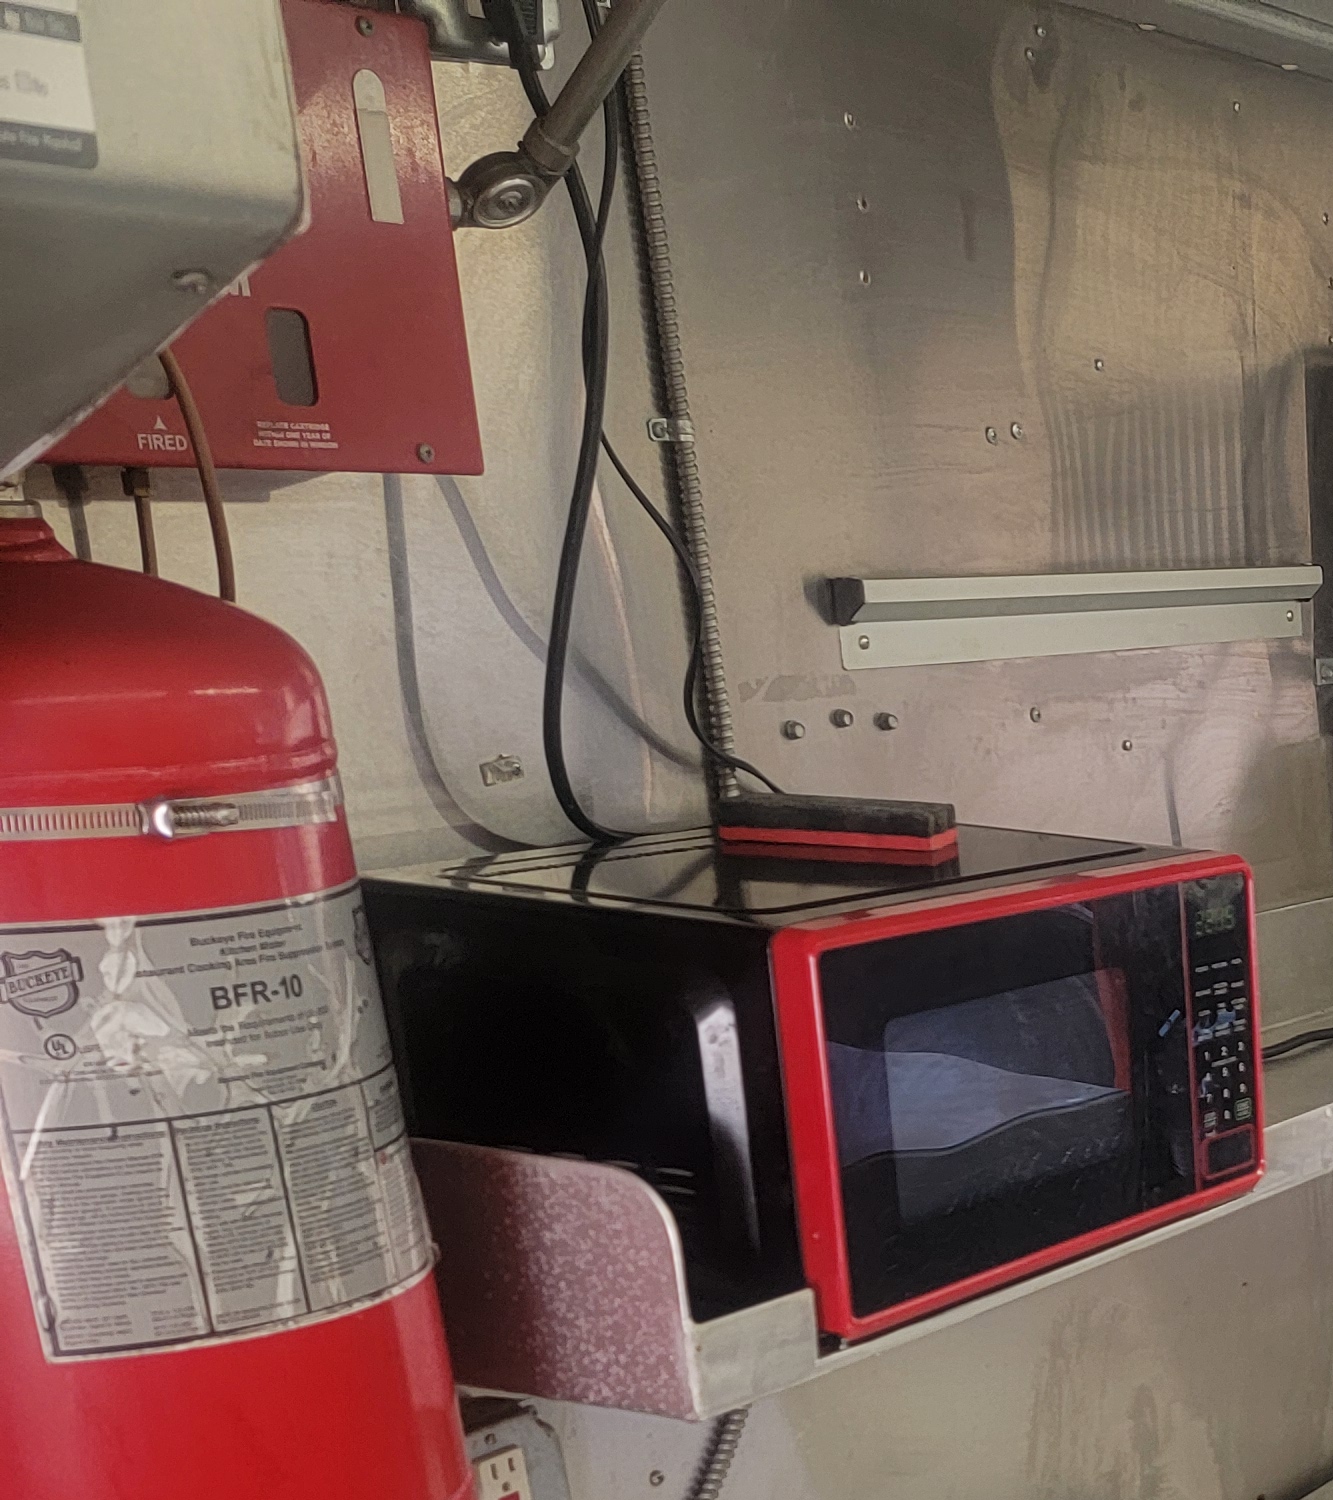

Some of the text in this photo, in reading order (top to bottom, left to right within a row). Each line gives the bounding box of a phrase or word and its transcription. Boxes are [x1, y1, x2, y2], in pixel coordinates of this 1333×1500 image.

[137, 433, 188, 451] FIRED
[8, 966, 69, 994] BUCKEYE
[210, 973, 303, 1011] BFR-10
[1221, 1046, 1228, 1056] 2
